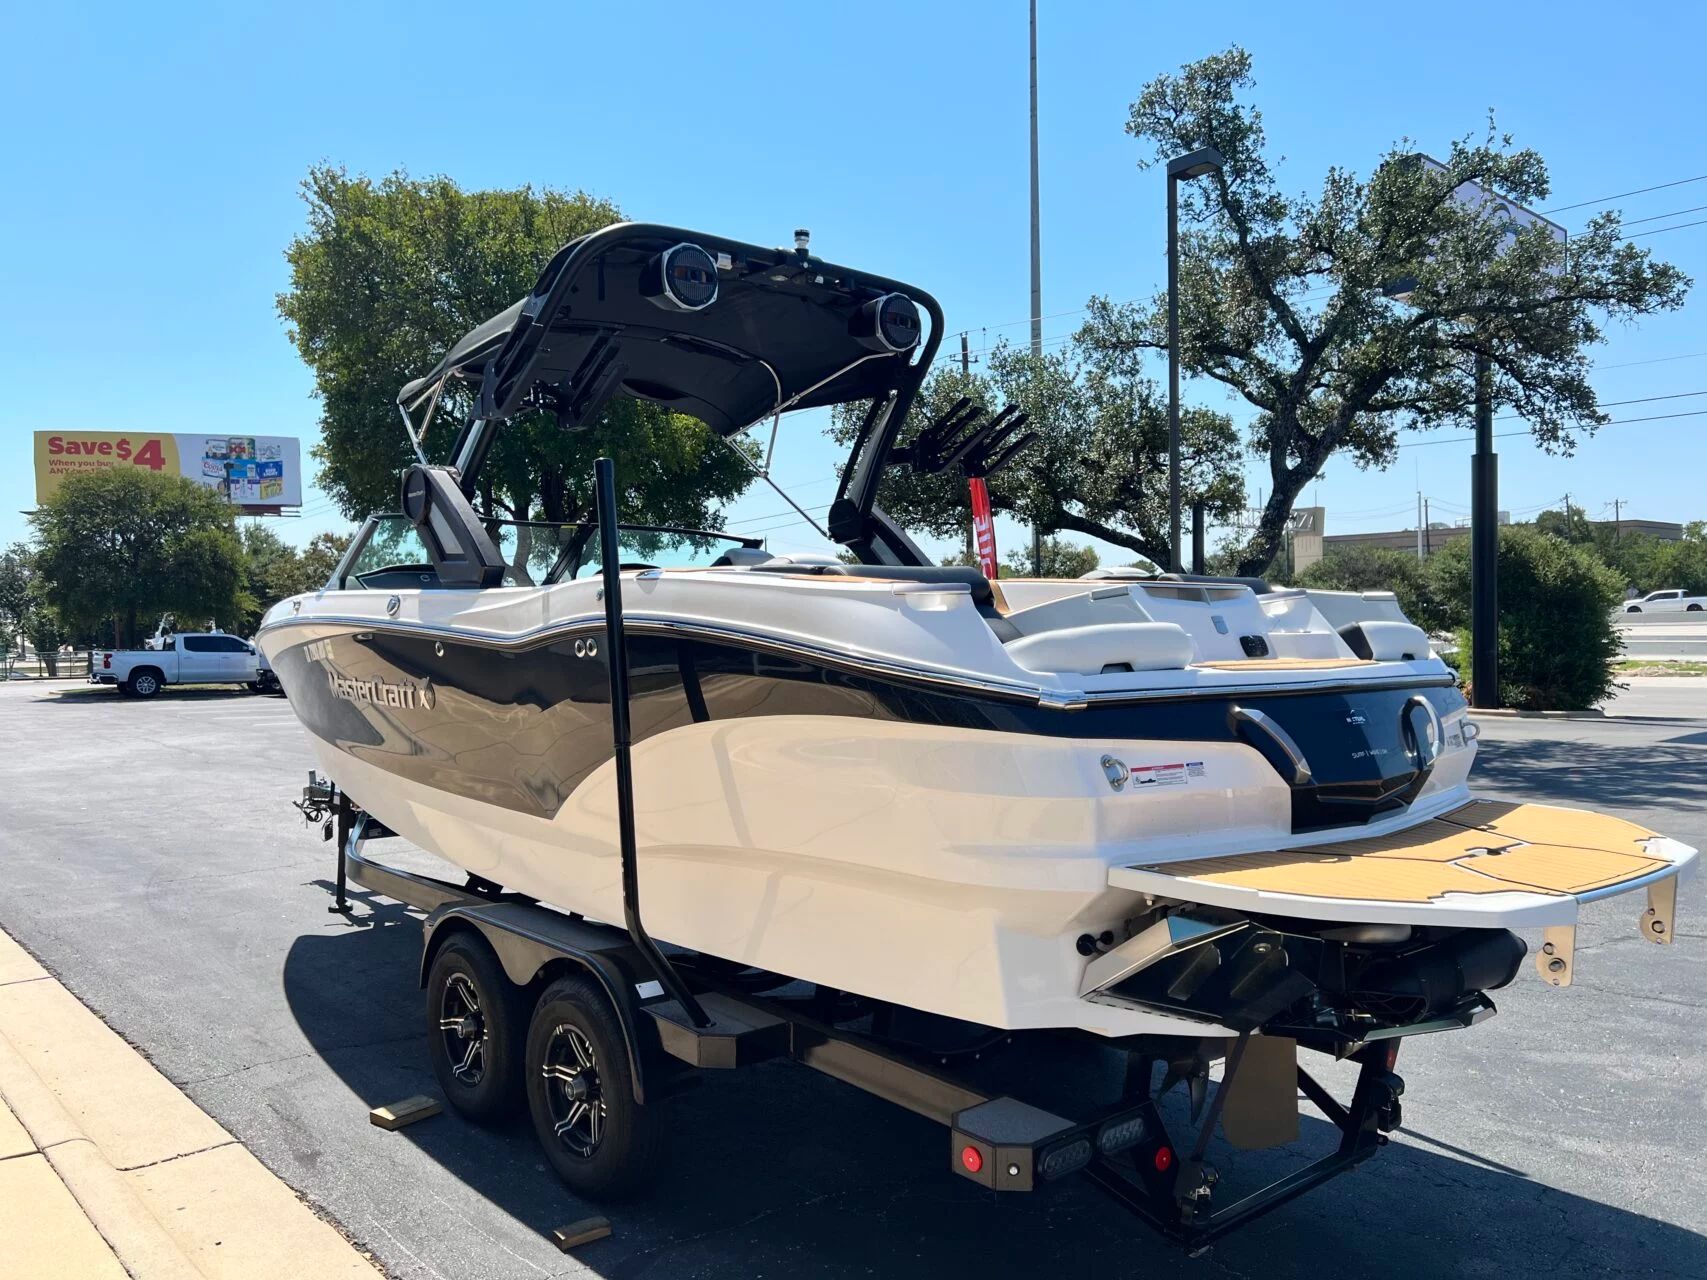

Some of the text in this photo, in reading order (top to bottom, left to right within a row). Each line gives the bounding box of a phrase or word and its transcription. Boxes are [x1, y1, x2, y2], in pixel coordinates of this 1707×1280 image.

[48, 436, 113, 455] Save
[97, 460, 114, 468] buy
[328, 671, 417, 710] MasterCraft
